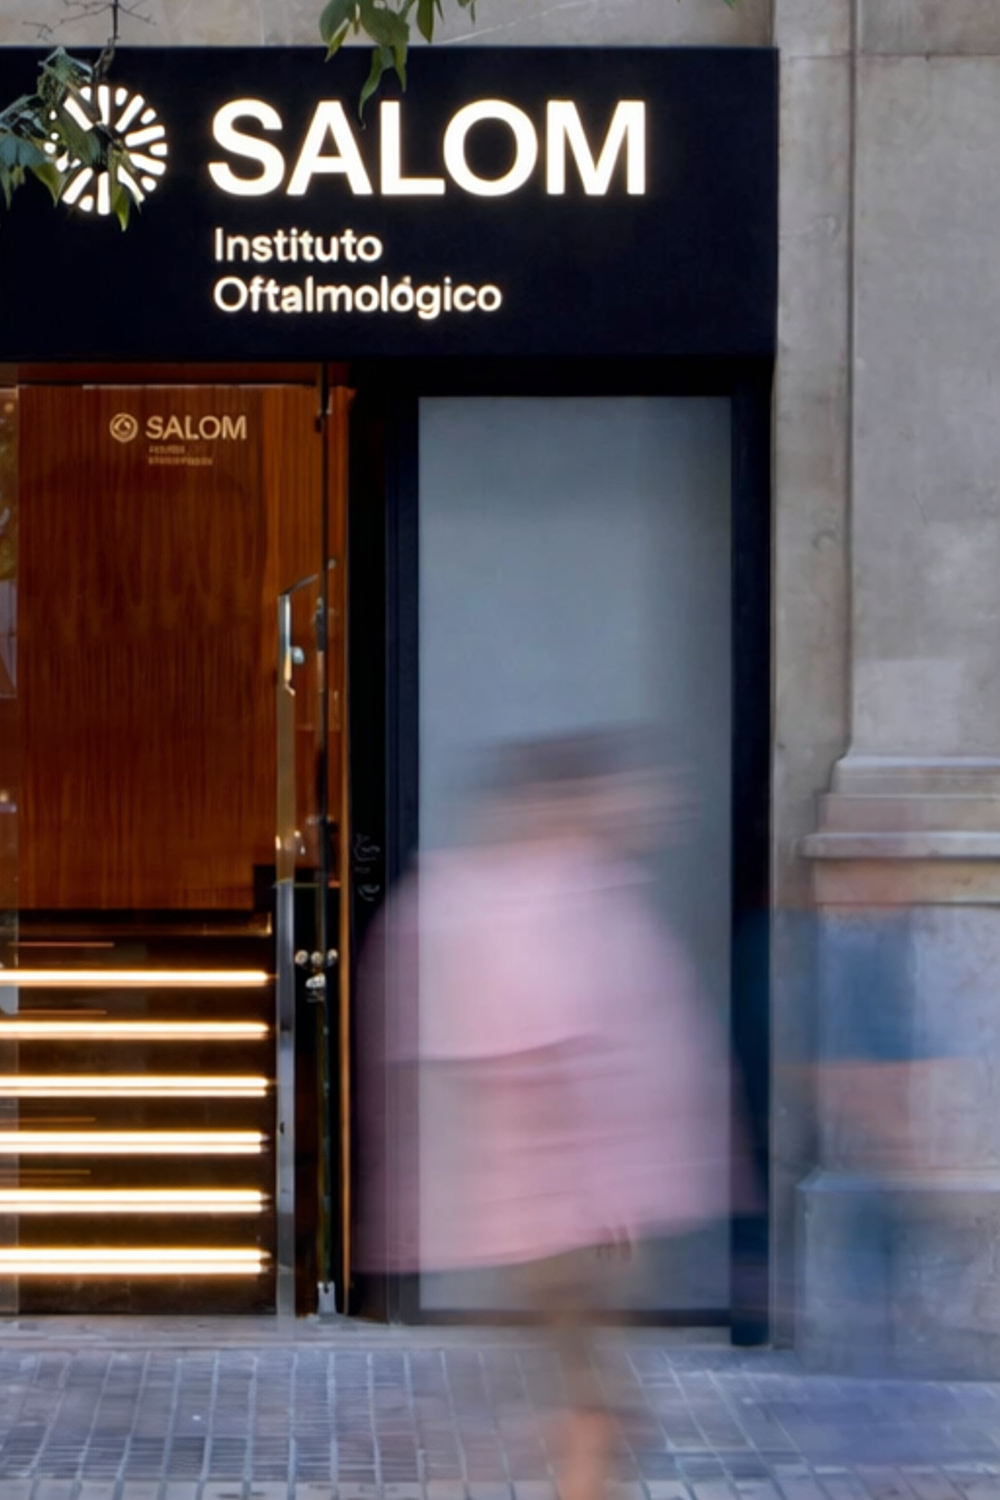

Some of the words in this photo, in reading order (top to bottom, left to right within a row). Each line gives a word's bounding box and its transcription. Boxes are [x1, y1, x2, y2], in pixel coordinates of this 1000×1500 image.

[208, 98, 647, 197] SALOM
[213, 226, 384, 264] Instituto
[212, 275, 503, 320] Oftalmológico
[145, 414, 248, 441] SALOM
